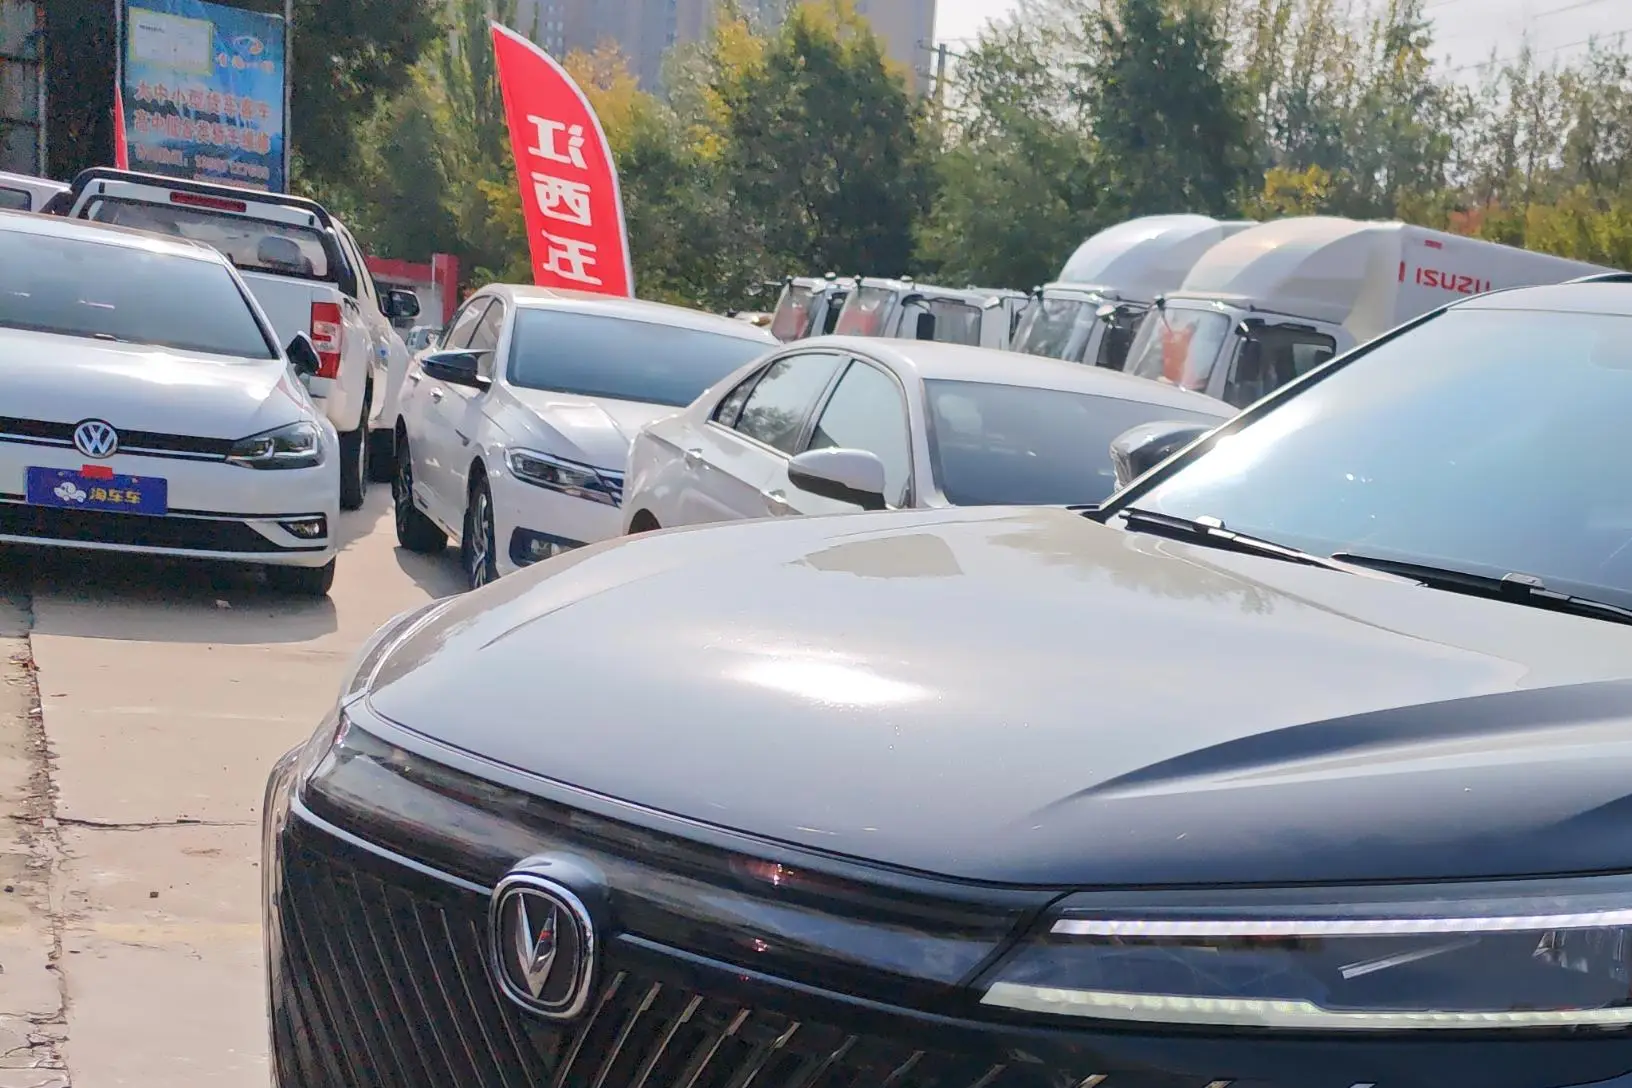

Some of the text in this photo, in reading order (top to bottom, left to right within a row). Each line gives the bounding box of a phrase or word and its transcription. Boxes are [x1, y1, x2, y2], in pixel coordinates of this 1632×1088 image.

[1416, 267, 1491, 294] ISUZU
[89, 487, 142, 504] 淘车车
